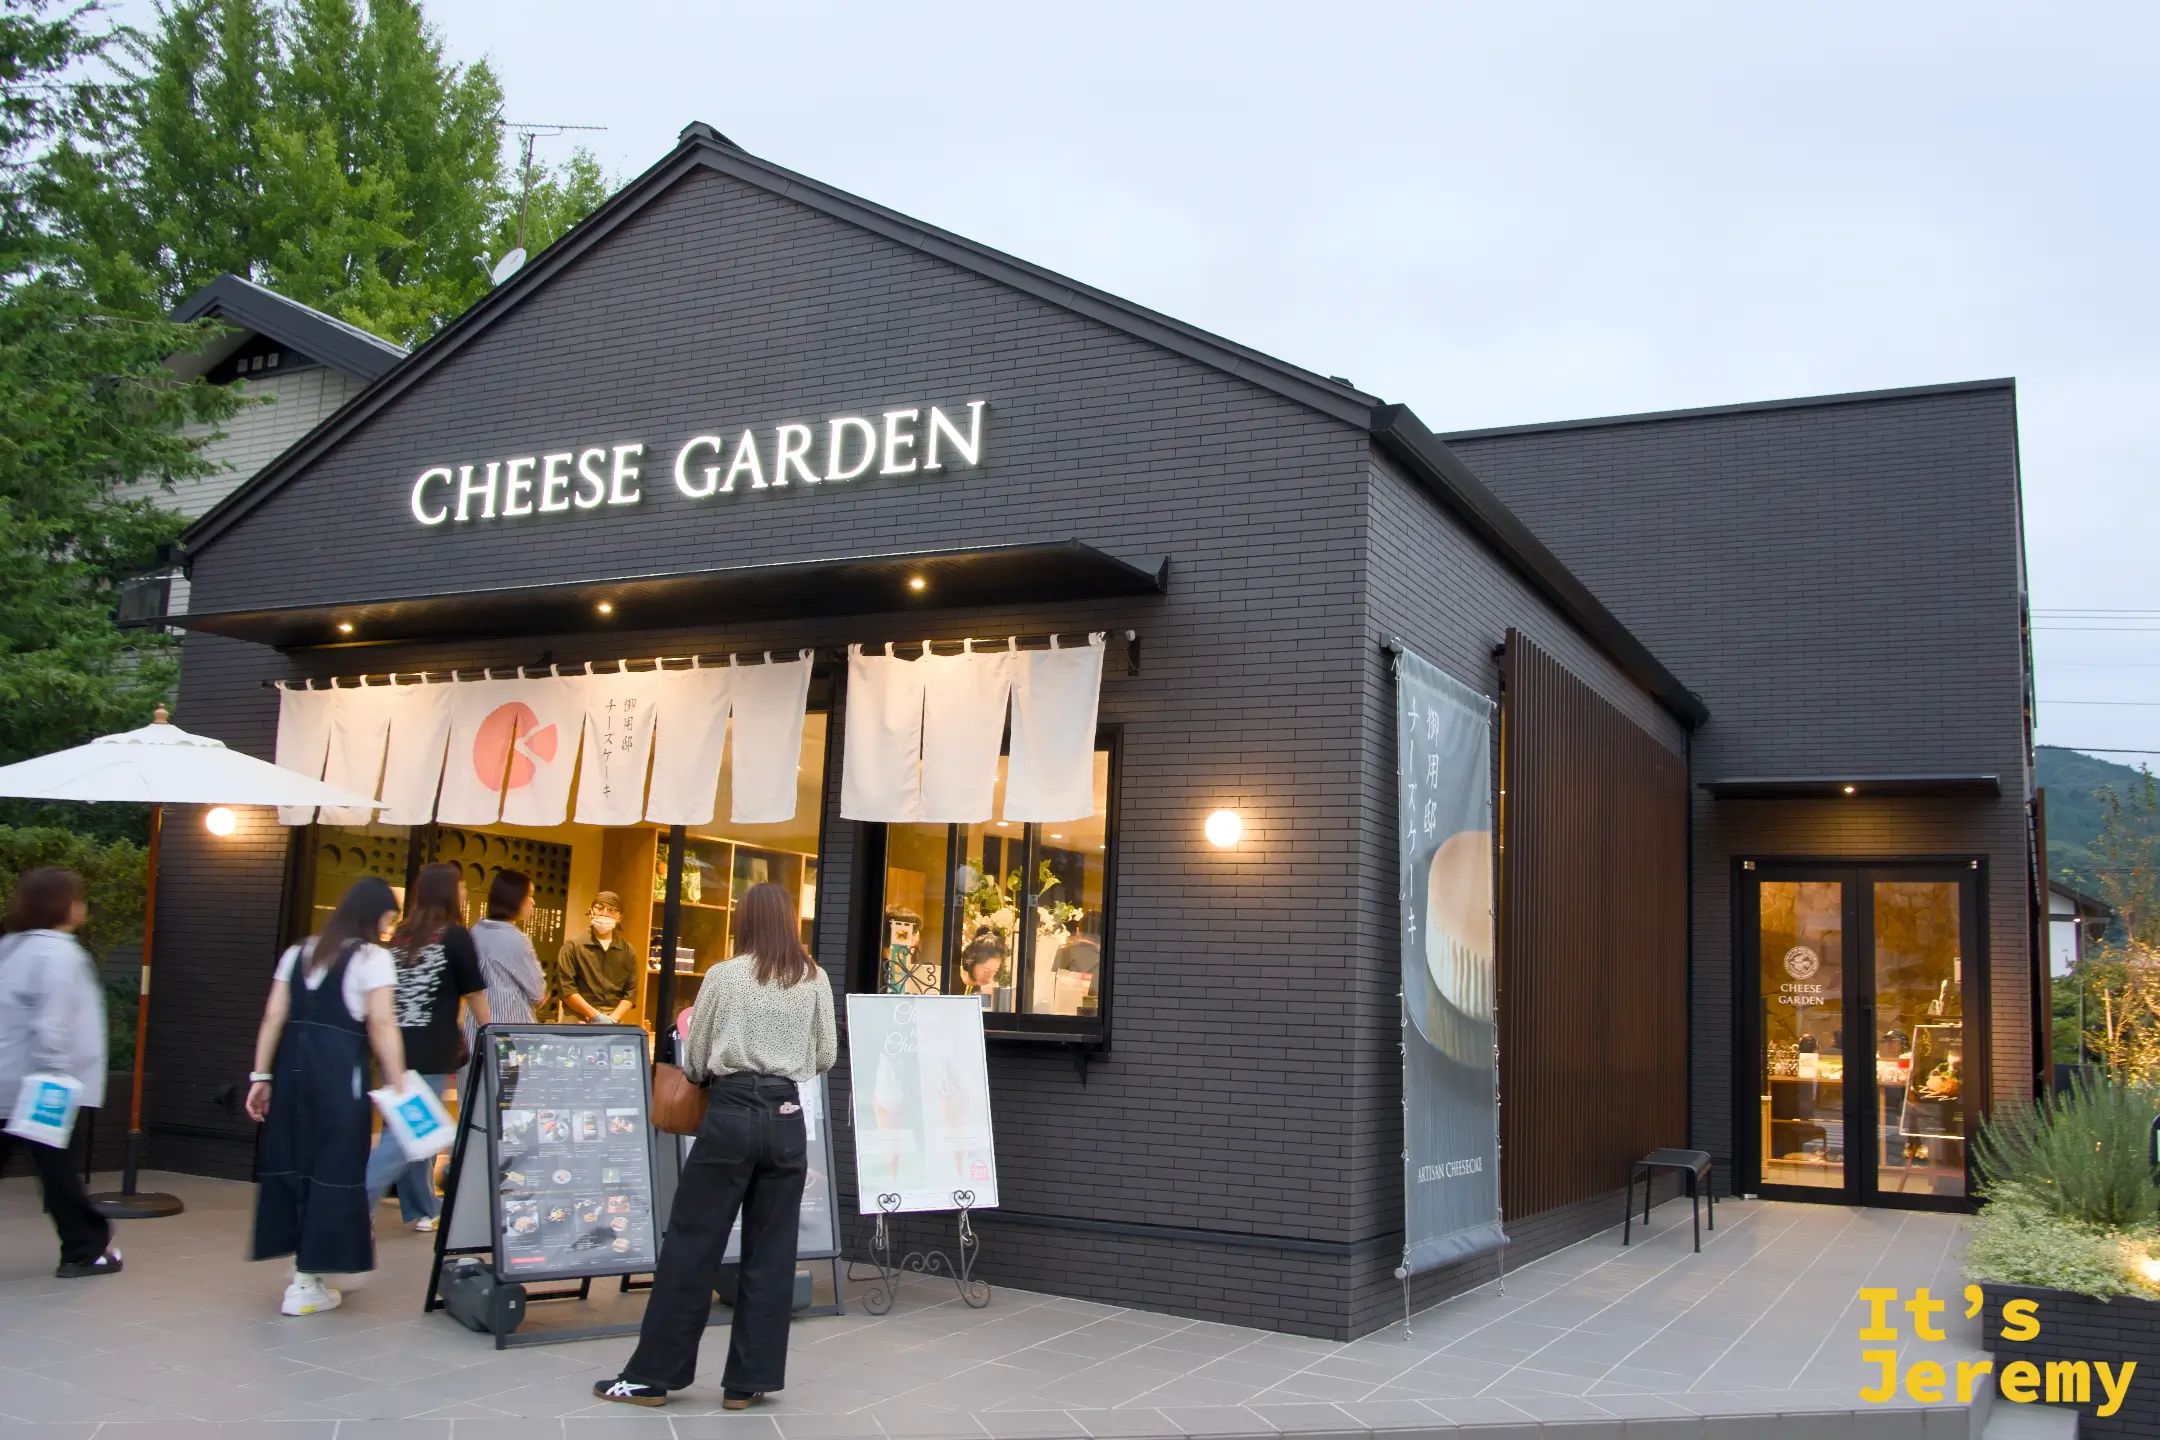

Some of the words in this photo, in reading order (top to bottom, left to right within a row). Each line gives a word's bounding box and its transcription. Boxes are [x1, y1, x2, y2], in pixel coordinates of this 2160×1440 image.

[411, 443, 644, 526] CHEESE
[674, 400, 986, 499] GARDEN
[603, 698, 617, 798] チーズケーキ
[622, 697, 637, 752] 御用邸
[1423, 706, 1440, 839] 御用邸
[1407, 696, 1420, 945] チーズケーキ
[1778, 995, 1825, 1006] GARDEN
[1780, 983, 1822, 993] CHEESE
[1418, 1163, 1445, 1184] ARTISAN
